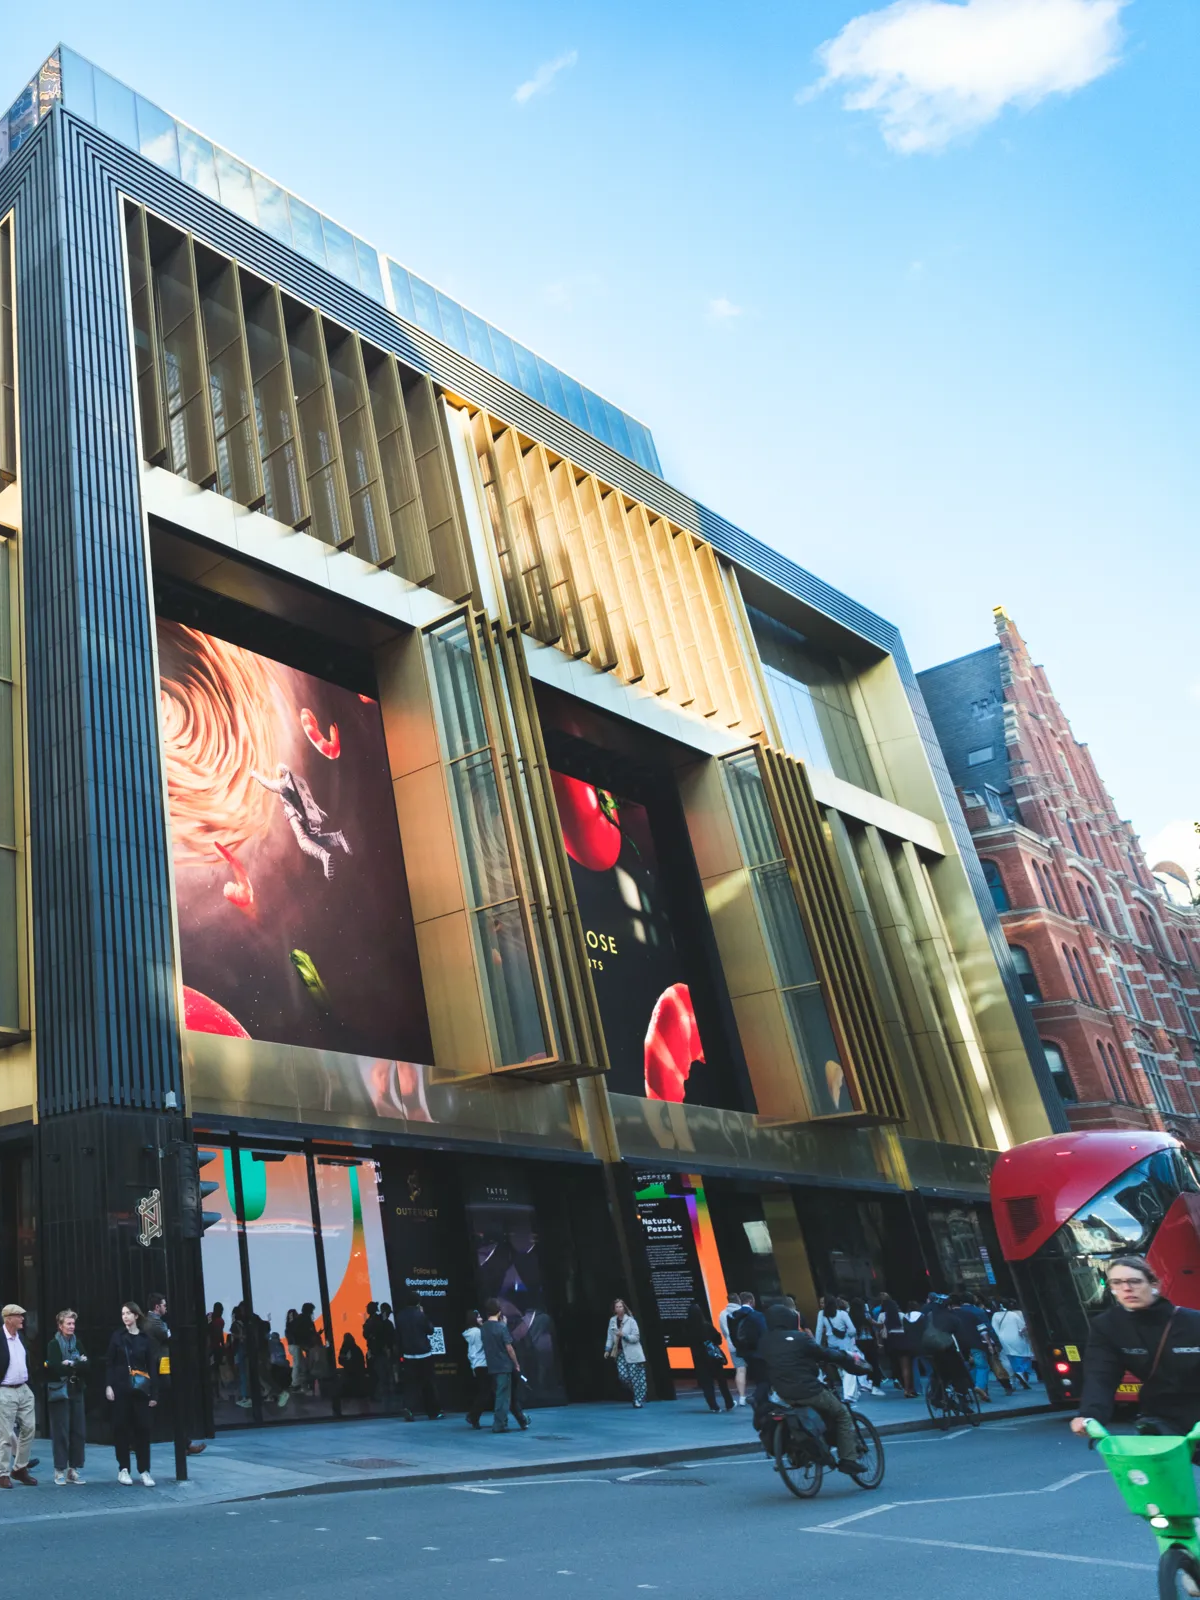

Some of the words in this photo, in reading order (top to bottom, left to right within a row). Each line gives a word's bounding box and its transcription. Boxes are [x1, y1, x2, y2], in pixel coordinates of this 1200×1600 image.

[585, 930, 618, 954] OSE
[396, 1207, 438, 1217] OUTERNET
[642, 1218, 675, 1226] Nature,
[647, 1225, 683, 1233] Persist
[405, 1278, 448, 1287] @outernetglobal
[415, 1289, 446, 1297] ternet.com
